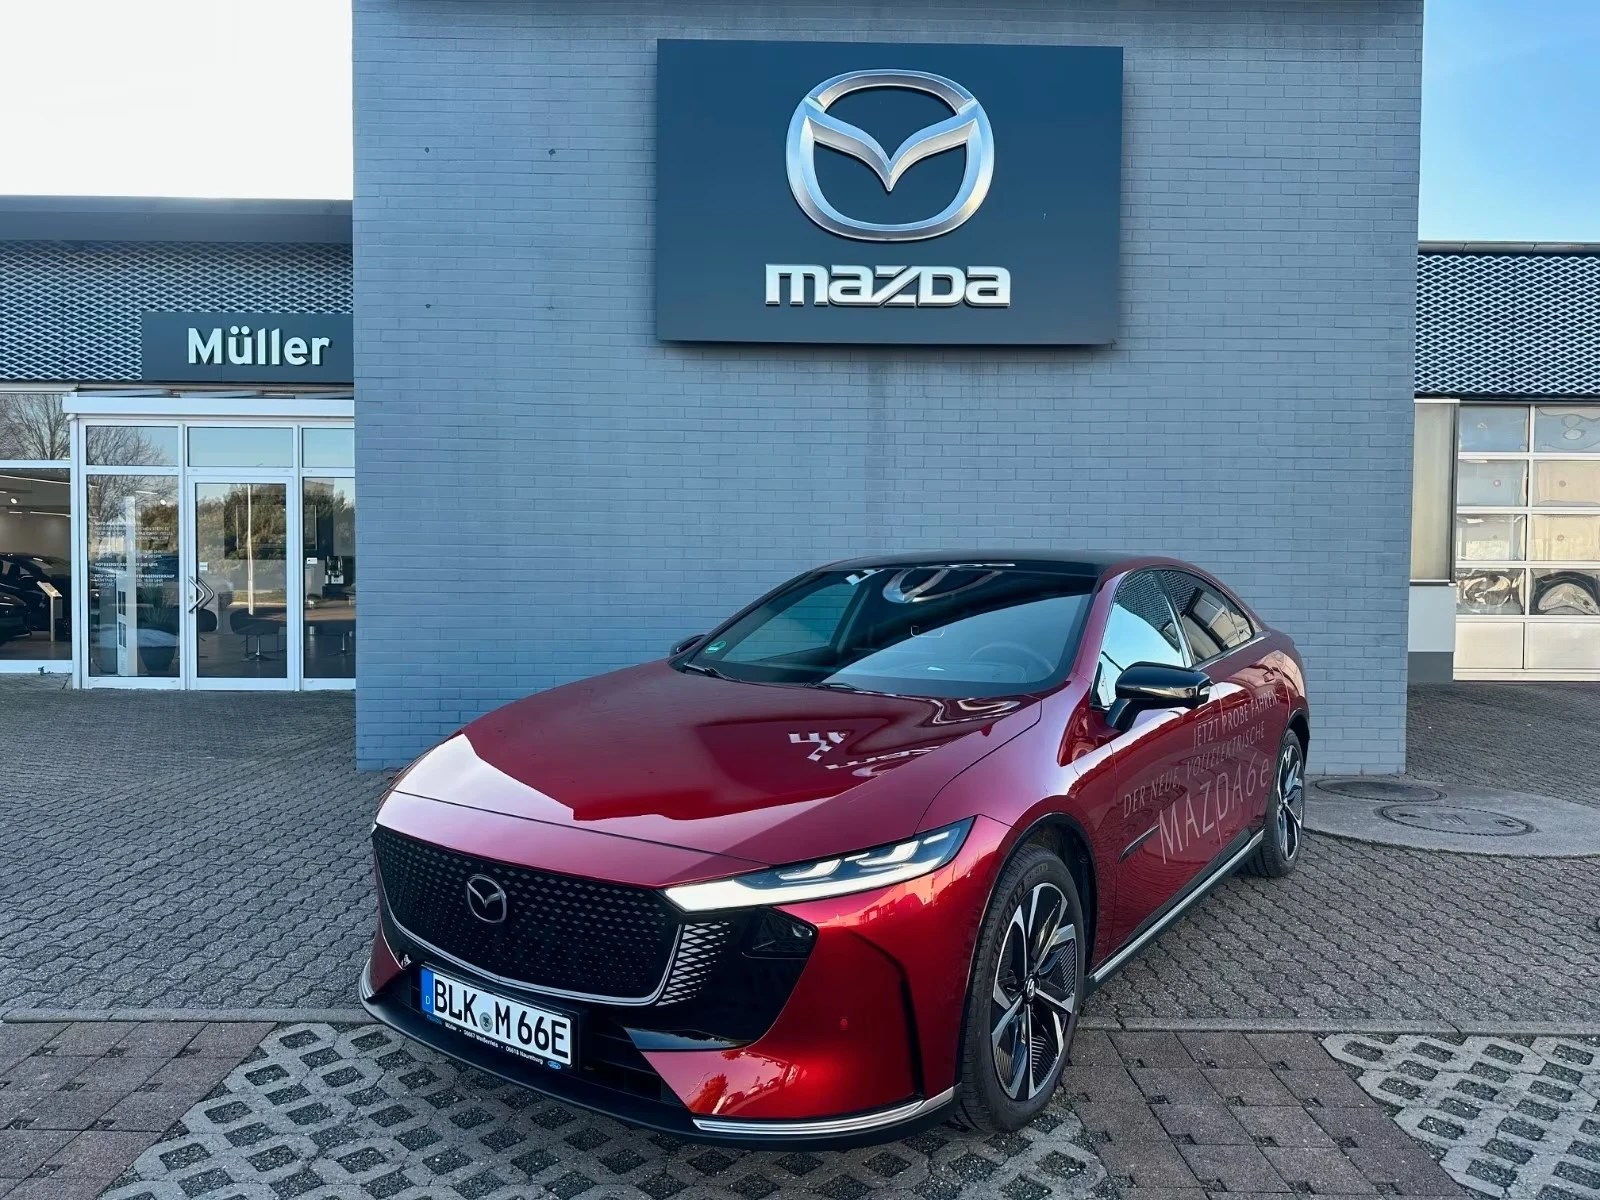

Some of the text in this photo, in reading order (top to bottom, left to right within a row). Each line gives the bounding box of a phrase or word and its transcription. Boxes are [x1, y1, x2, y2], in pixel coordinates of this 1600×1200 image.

[188, 326, 331, 366] Müller
[1193, 717, 1220, 752] JETZT
[1221, 703, 1249, 734] PROBE
[1123, 785, 1147, 819] DER
[1187, 722, 1265, 781] VOLLELEKTRISCHE
[425, 979, 569, 1059] D BLK M 66E
